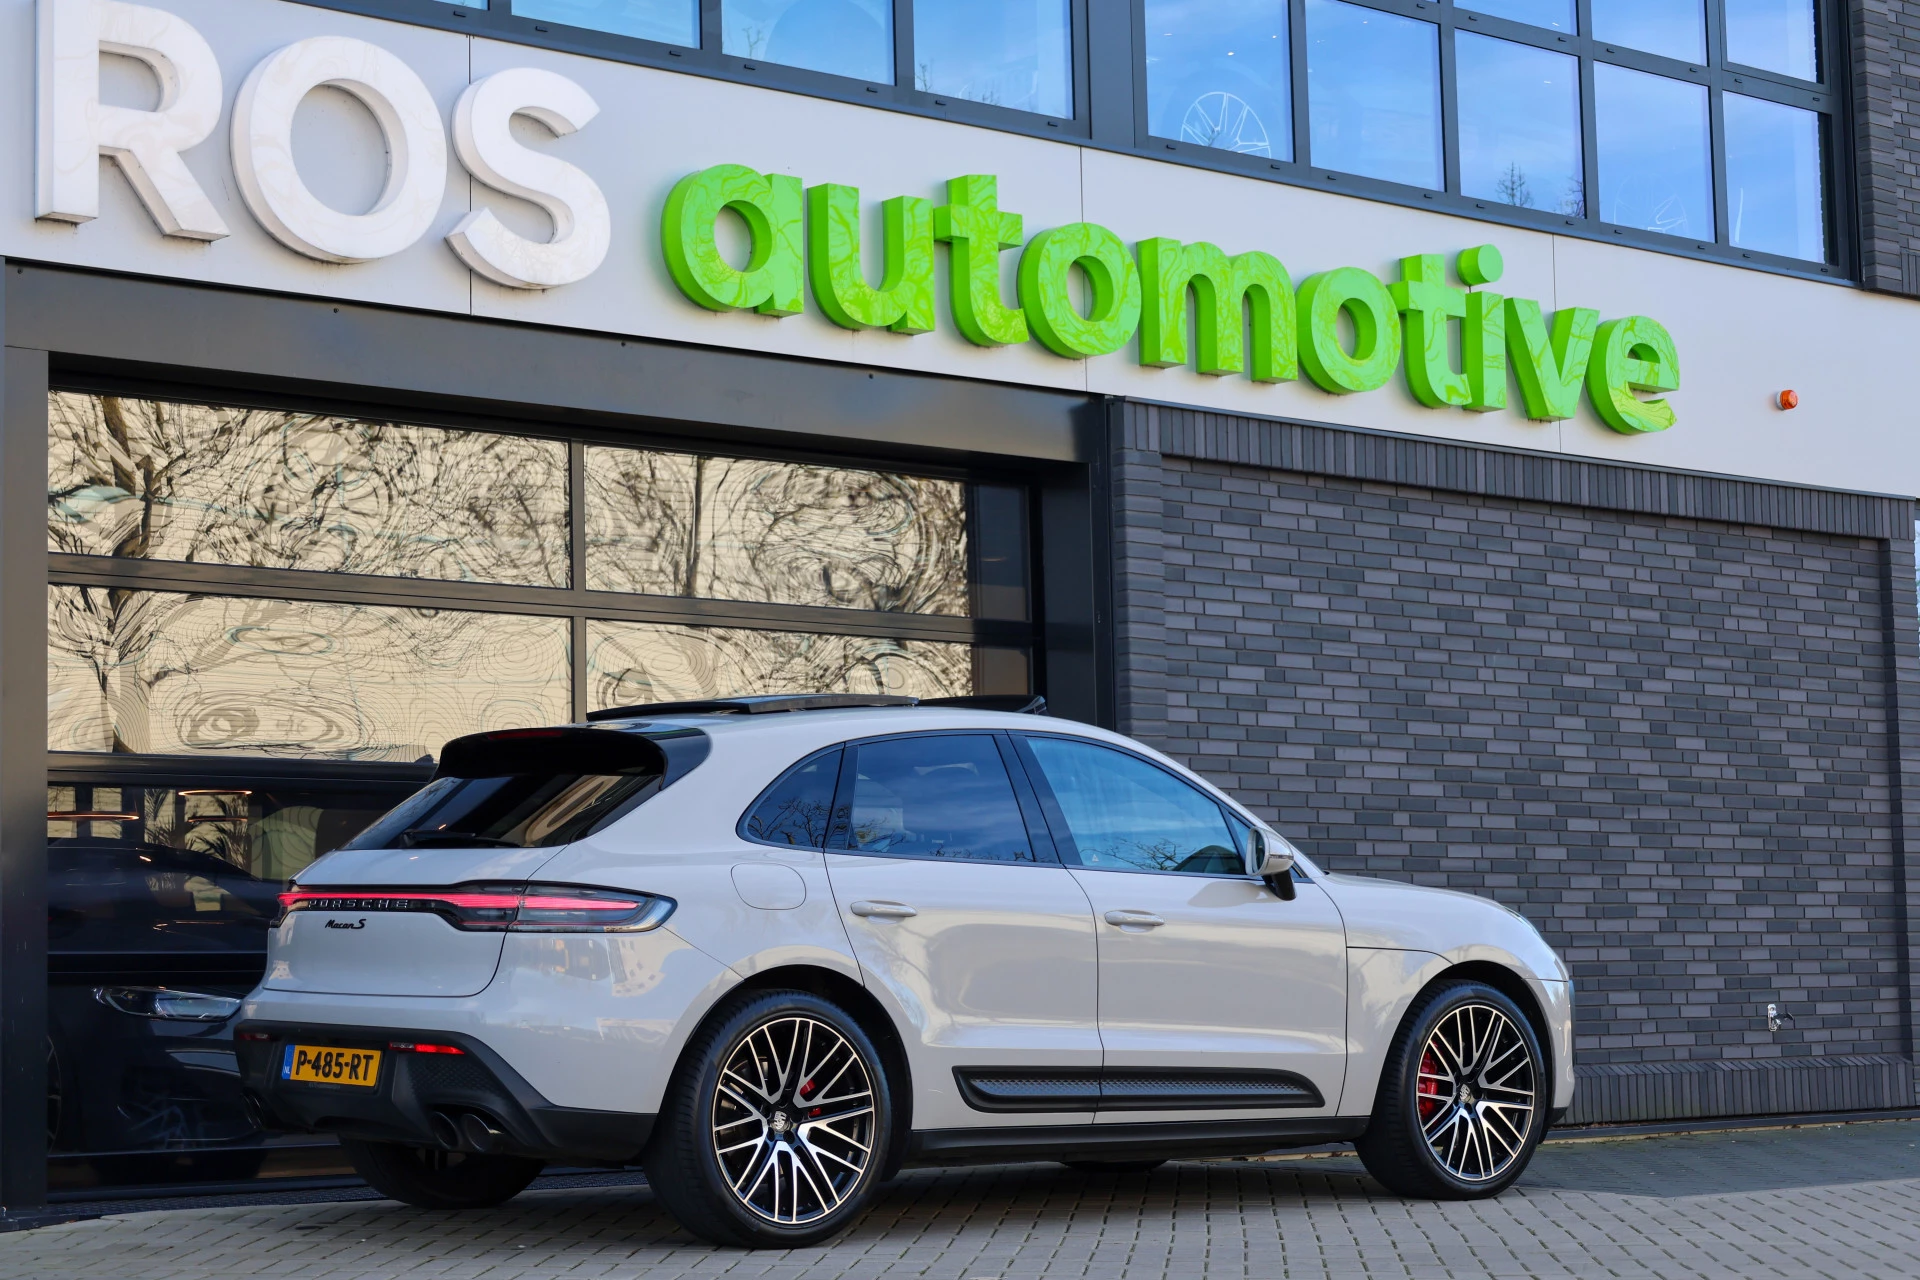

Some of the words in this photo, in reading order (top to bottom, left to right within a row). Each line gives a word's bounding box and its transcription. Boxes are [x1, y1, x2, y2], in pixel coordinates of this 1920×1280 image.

[35, 0, 611, 290] ROS
[661, 164, 1680, 435] automotive
[308, 899, 408, 909] PORSCHE
[325, 919, 354, 929] Macan
[353, 918, 367, 930] S
[283, 1066, 291, 1074] NL
[295, 1050, 375, 1081] P-485-RT
